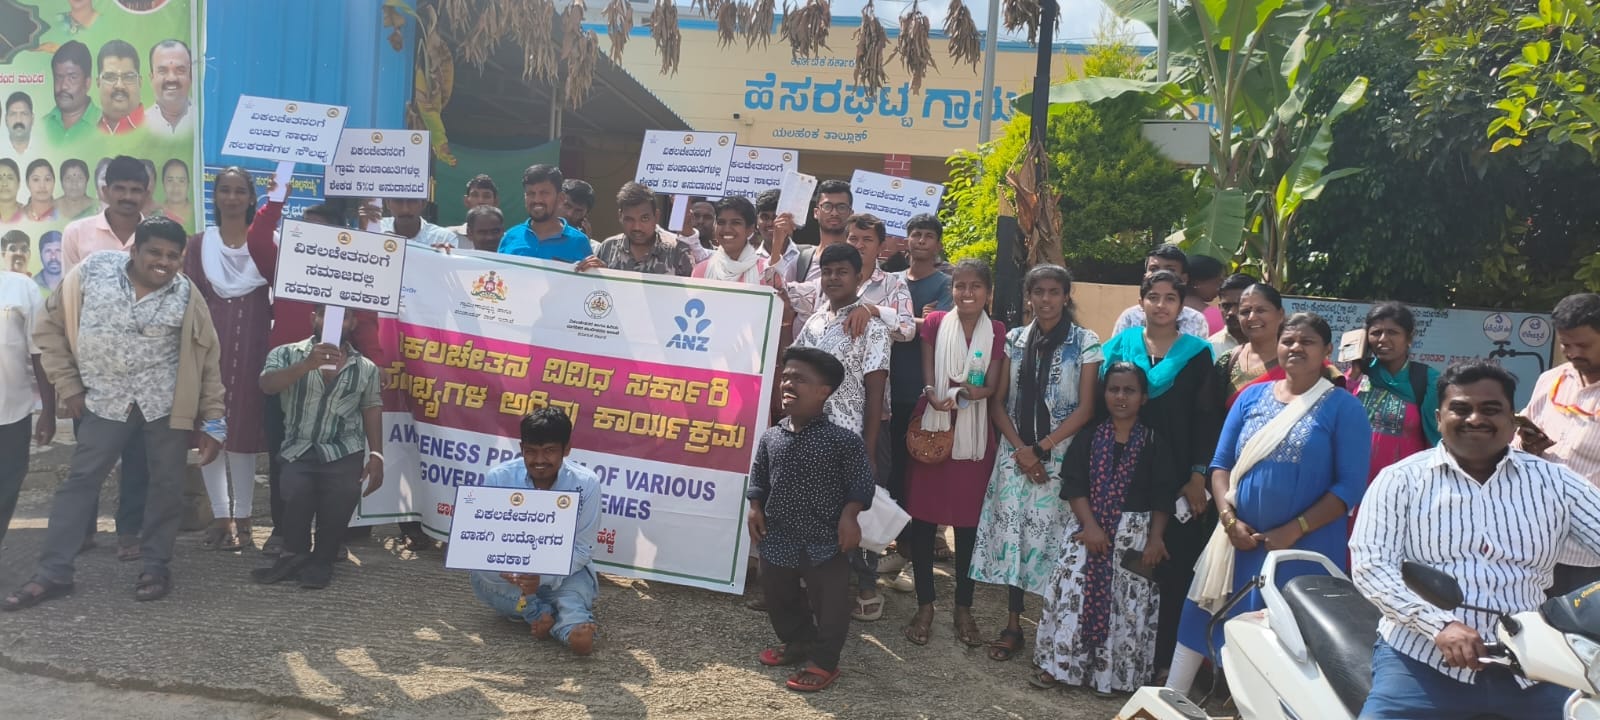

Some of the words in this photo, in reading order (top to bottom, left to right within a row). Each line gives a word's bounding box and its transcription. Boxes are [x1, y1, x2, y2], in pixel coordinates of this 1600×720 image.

[251, 112, 327, 128] ವಿಕಲಚೇತನರಿಗೆ
[249, 127, 281, 138] ಉಚಿತ
[285, 131, 318, 142] ಸಾಧನ
[772, 127, 820, 139] ಯಲಹಂಕ
[229, 140, 291, 154] ಸಲಕರಣೆಗಳ
[351, 146, 406, 157] ವಿಕಲಚೇತನರಿಗೆ
[662, 146, 712, 158] ವಿಕಲಚೇತನರಿಗೆ
[335, 164, 355, 176] ಗ್ರಾಮ
[646, 163, 665, 174] ಗ್ರಾಮ
[730, 161, 784, 172] ಕಲಚೇತನರಿಗೆ
[754, 177, 780, 186] ಸಾಧನ
[865, 202, 912, 217] ವಾತಾವರಣ
[294, 242, 391, 267] ವಿಕಲಚೇತನರಿಗೆ
[305, 264, 375, 288] ಸಮಾಜದಲ್ಲಿ
[284, 281, 333, 298] ಸಮಾನ
[339, 290, 391, 306] ಅವಕಾಶ
[666, 333, 711, 352] ANZ
[399, 332, 531, 378] ಕಲಚೇತನ
[542, 358, 615, 397] ವಿವಿಧ
[625, 372, 730, 408] ಸರ್ಕಾರಿ
[593, 405, 747, 454] ಕಾರ್ಯಕ್ರಮ
[389, 423, 481, 464] AWENESS
[593, 464, 619, 487] OF
[625, 469, 716, 502] VARIOUS
[601, 493, 652, 521] EMES
[474, 508, 556, 524] ವಿಕಲಚೇತನರಿಗೆ
[460, 529, 496, 541] ಖಾಸಗಿ
[501, 530, 564, 550] ಉದ್ಯೋಗದ
[487, 552, 531, 566] ಅವಕಾಶ
